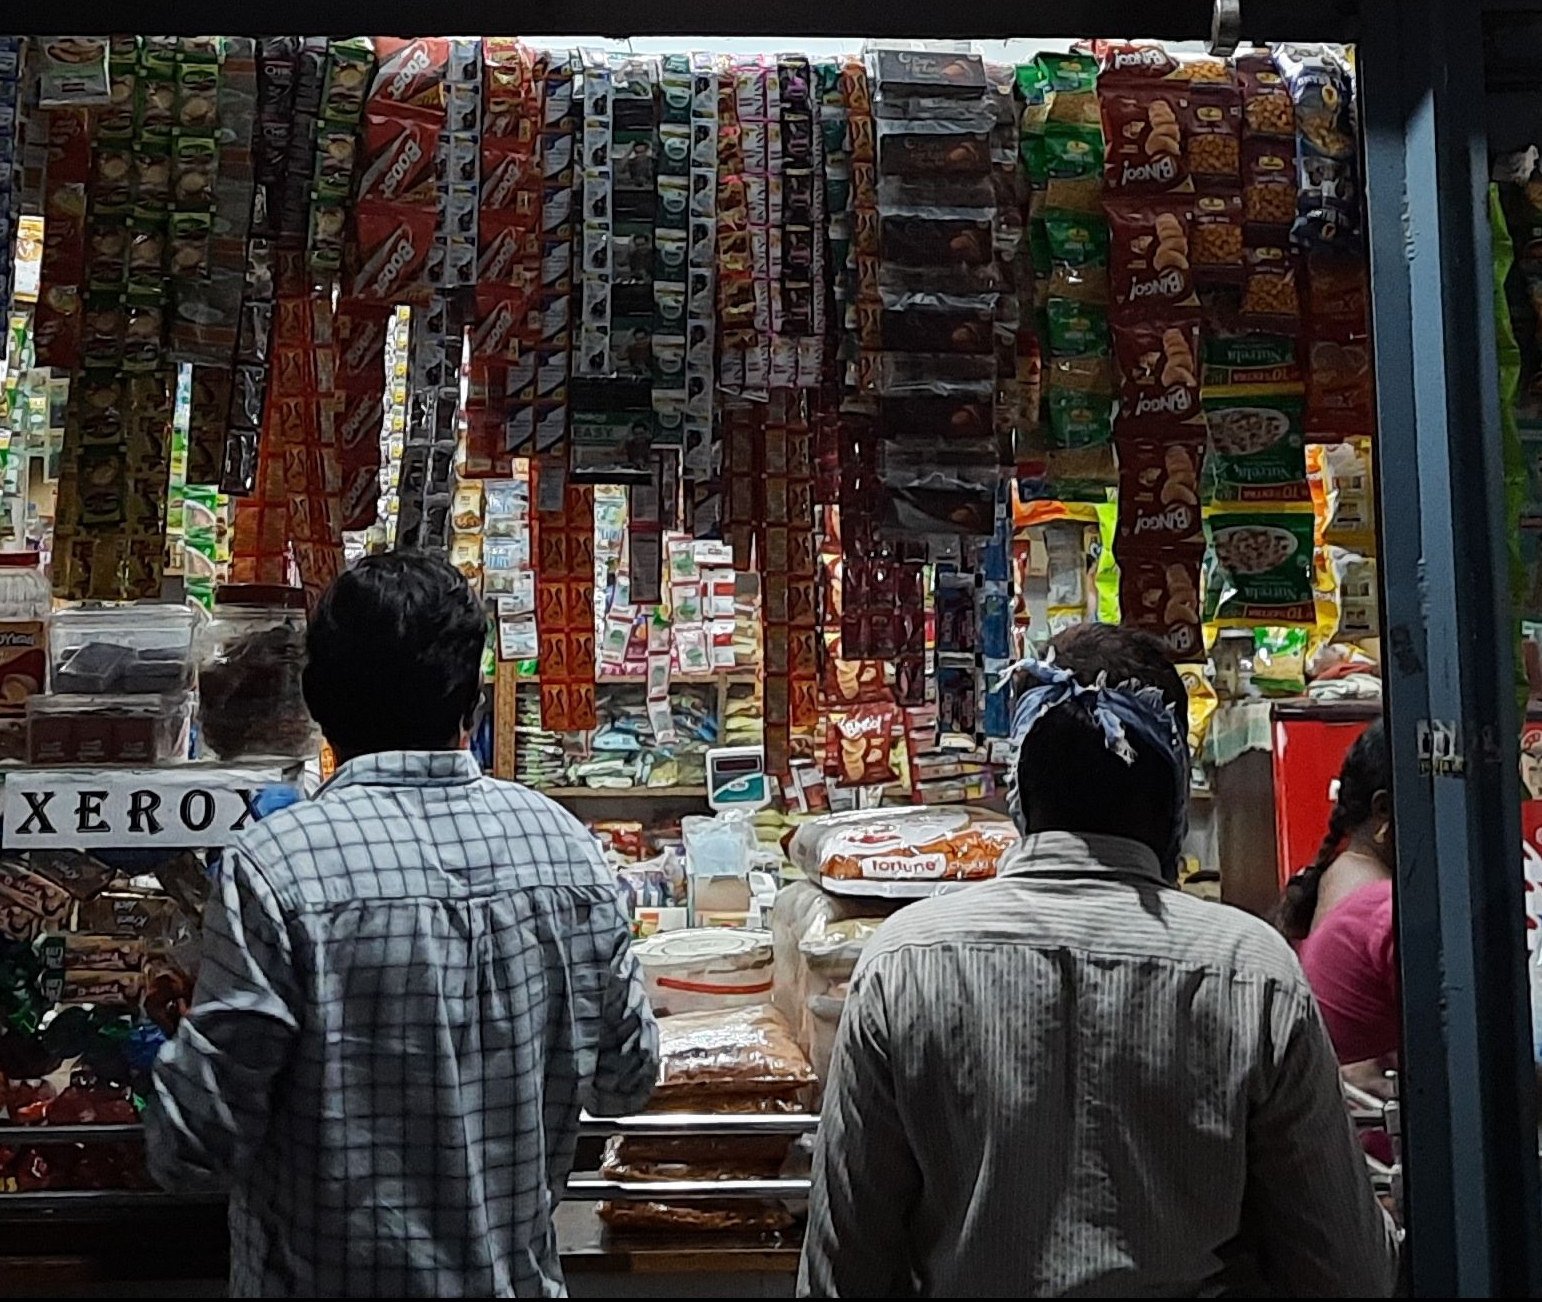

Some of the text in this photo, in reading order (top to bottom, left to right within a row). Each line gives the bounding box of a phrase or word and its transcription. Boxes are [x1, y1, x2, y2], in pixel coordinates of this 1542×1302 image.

[379, 136, 423, 200] BOOST
[1120, 156, 1178, 186] BINGO!
[1128, 268, 1186, 302] BINGO!
[1134, 387, 1192, 416] BINGO!
[1133, 502, 1192, 536] BINGO!
